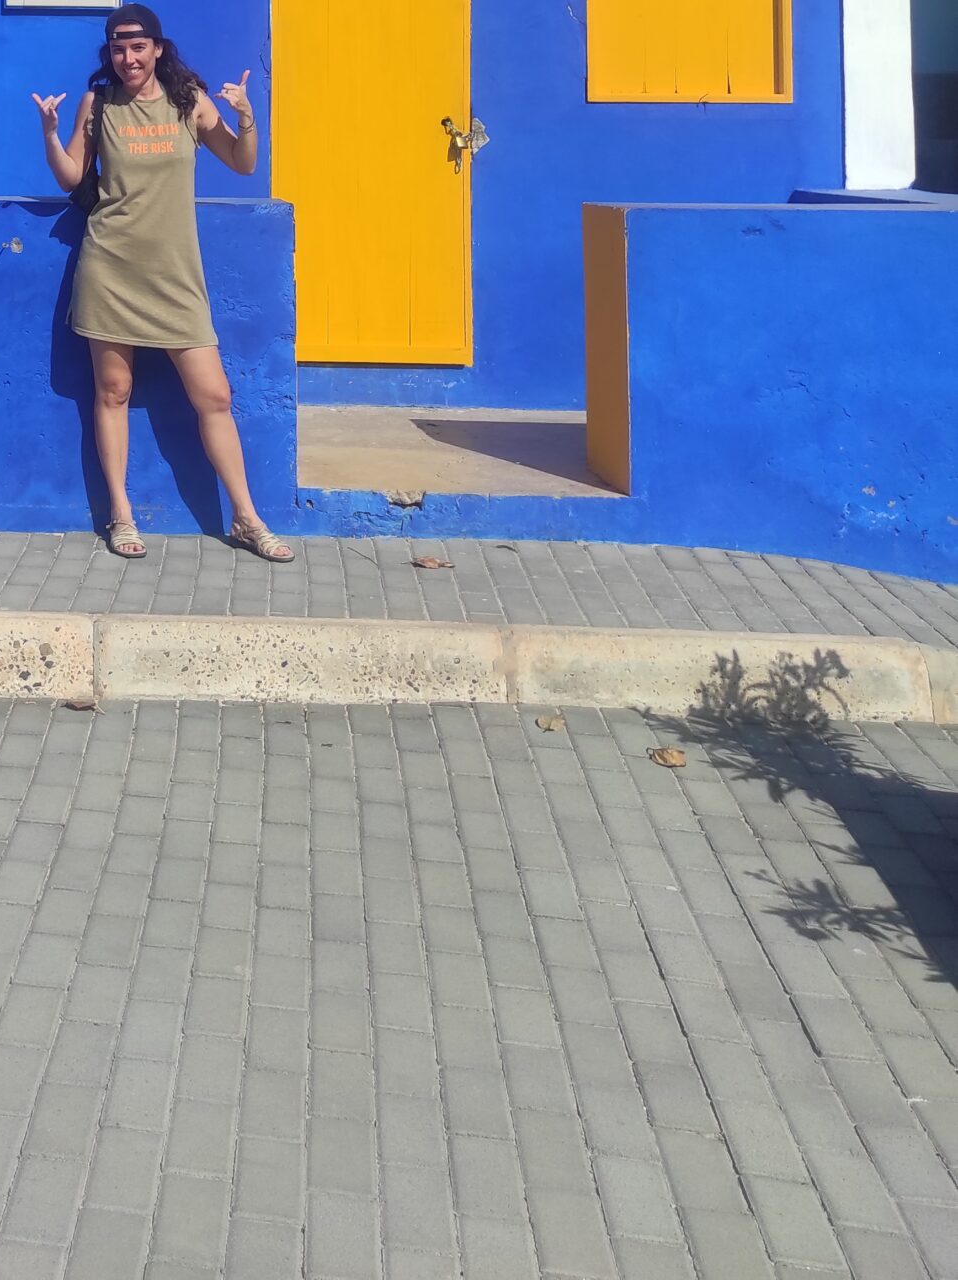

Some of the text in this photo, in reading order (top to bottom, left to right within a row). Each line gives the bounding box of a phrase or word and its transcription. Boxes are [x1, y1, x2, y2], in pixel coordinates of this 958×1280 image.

[138, 123, 179, 137] WORTH
[128, 141, 175, 154] THE RISK
